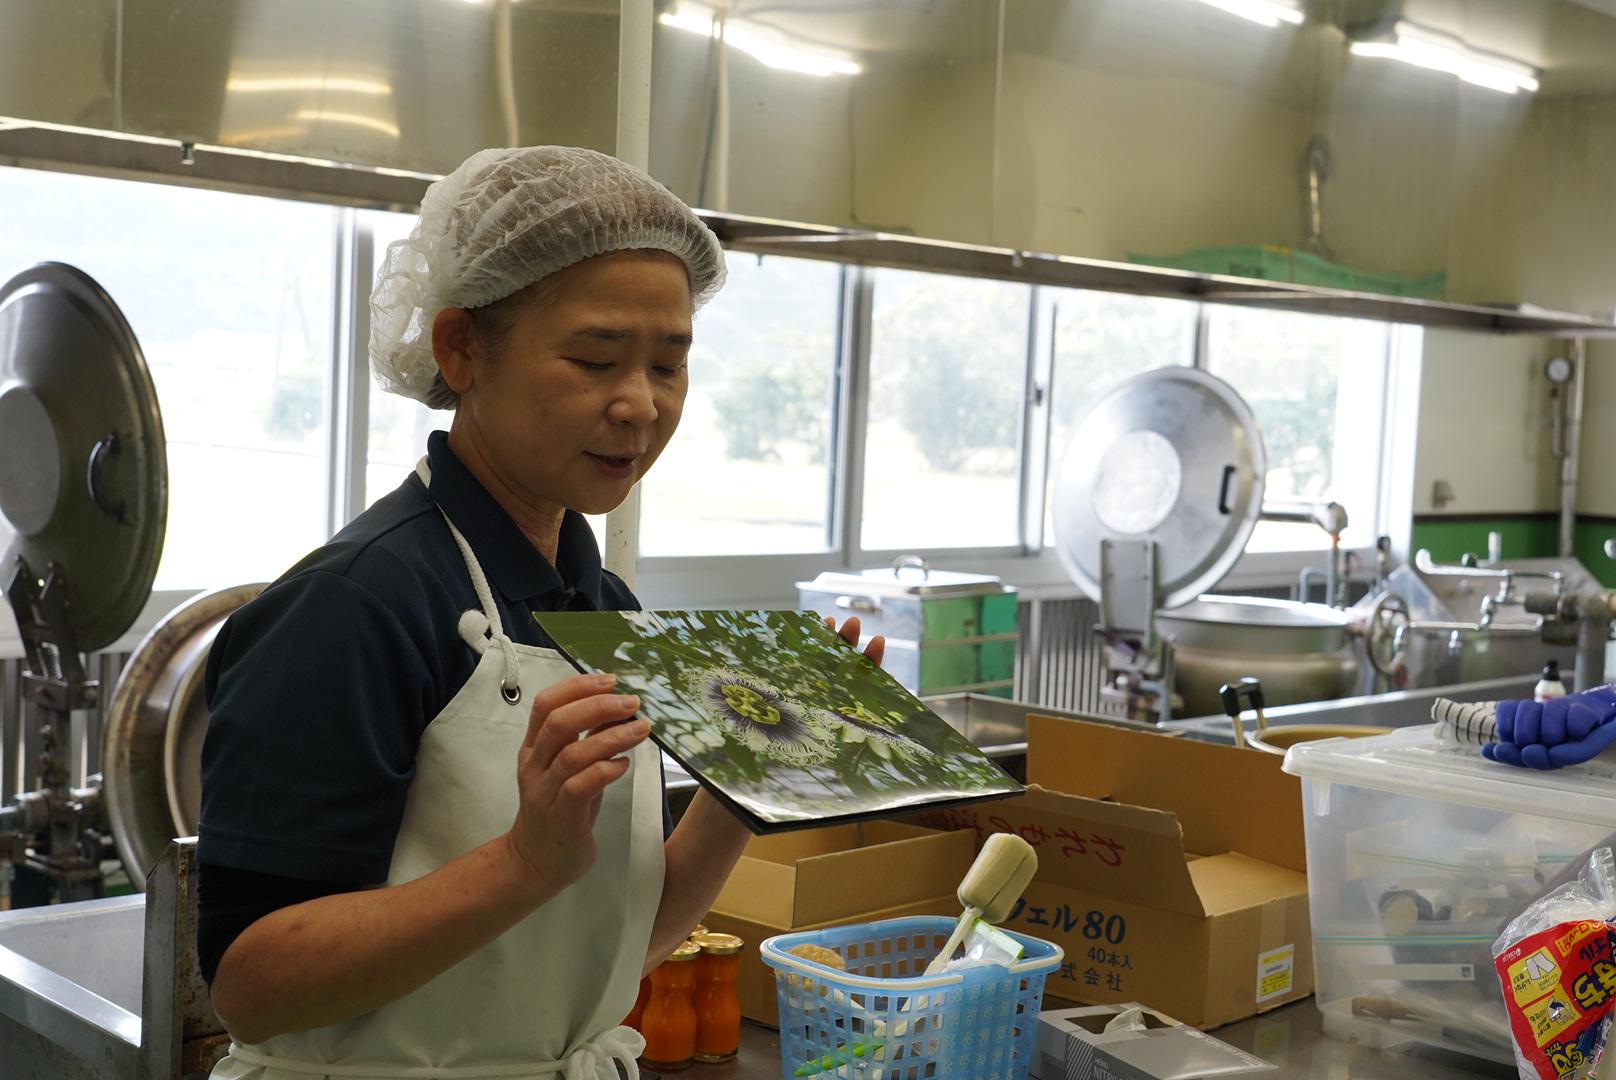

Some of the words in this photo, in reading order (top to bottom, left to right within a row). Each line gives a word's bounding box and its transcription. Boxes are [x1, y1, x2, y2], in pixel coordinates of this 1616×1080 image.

[1087, 946, 1133, 970] 40本入
[1047, 962, 1123, 992] 式会社
